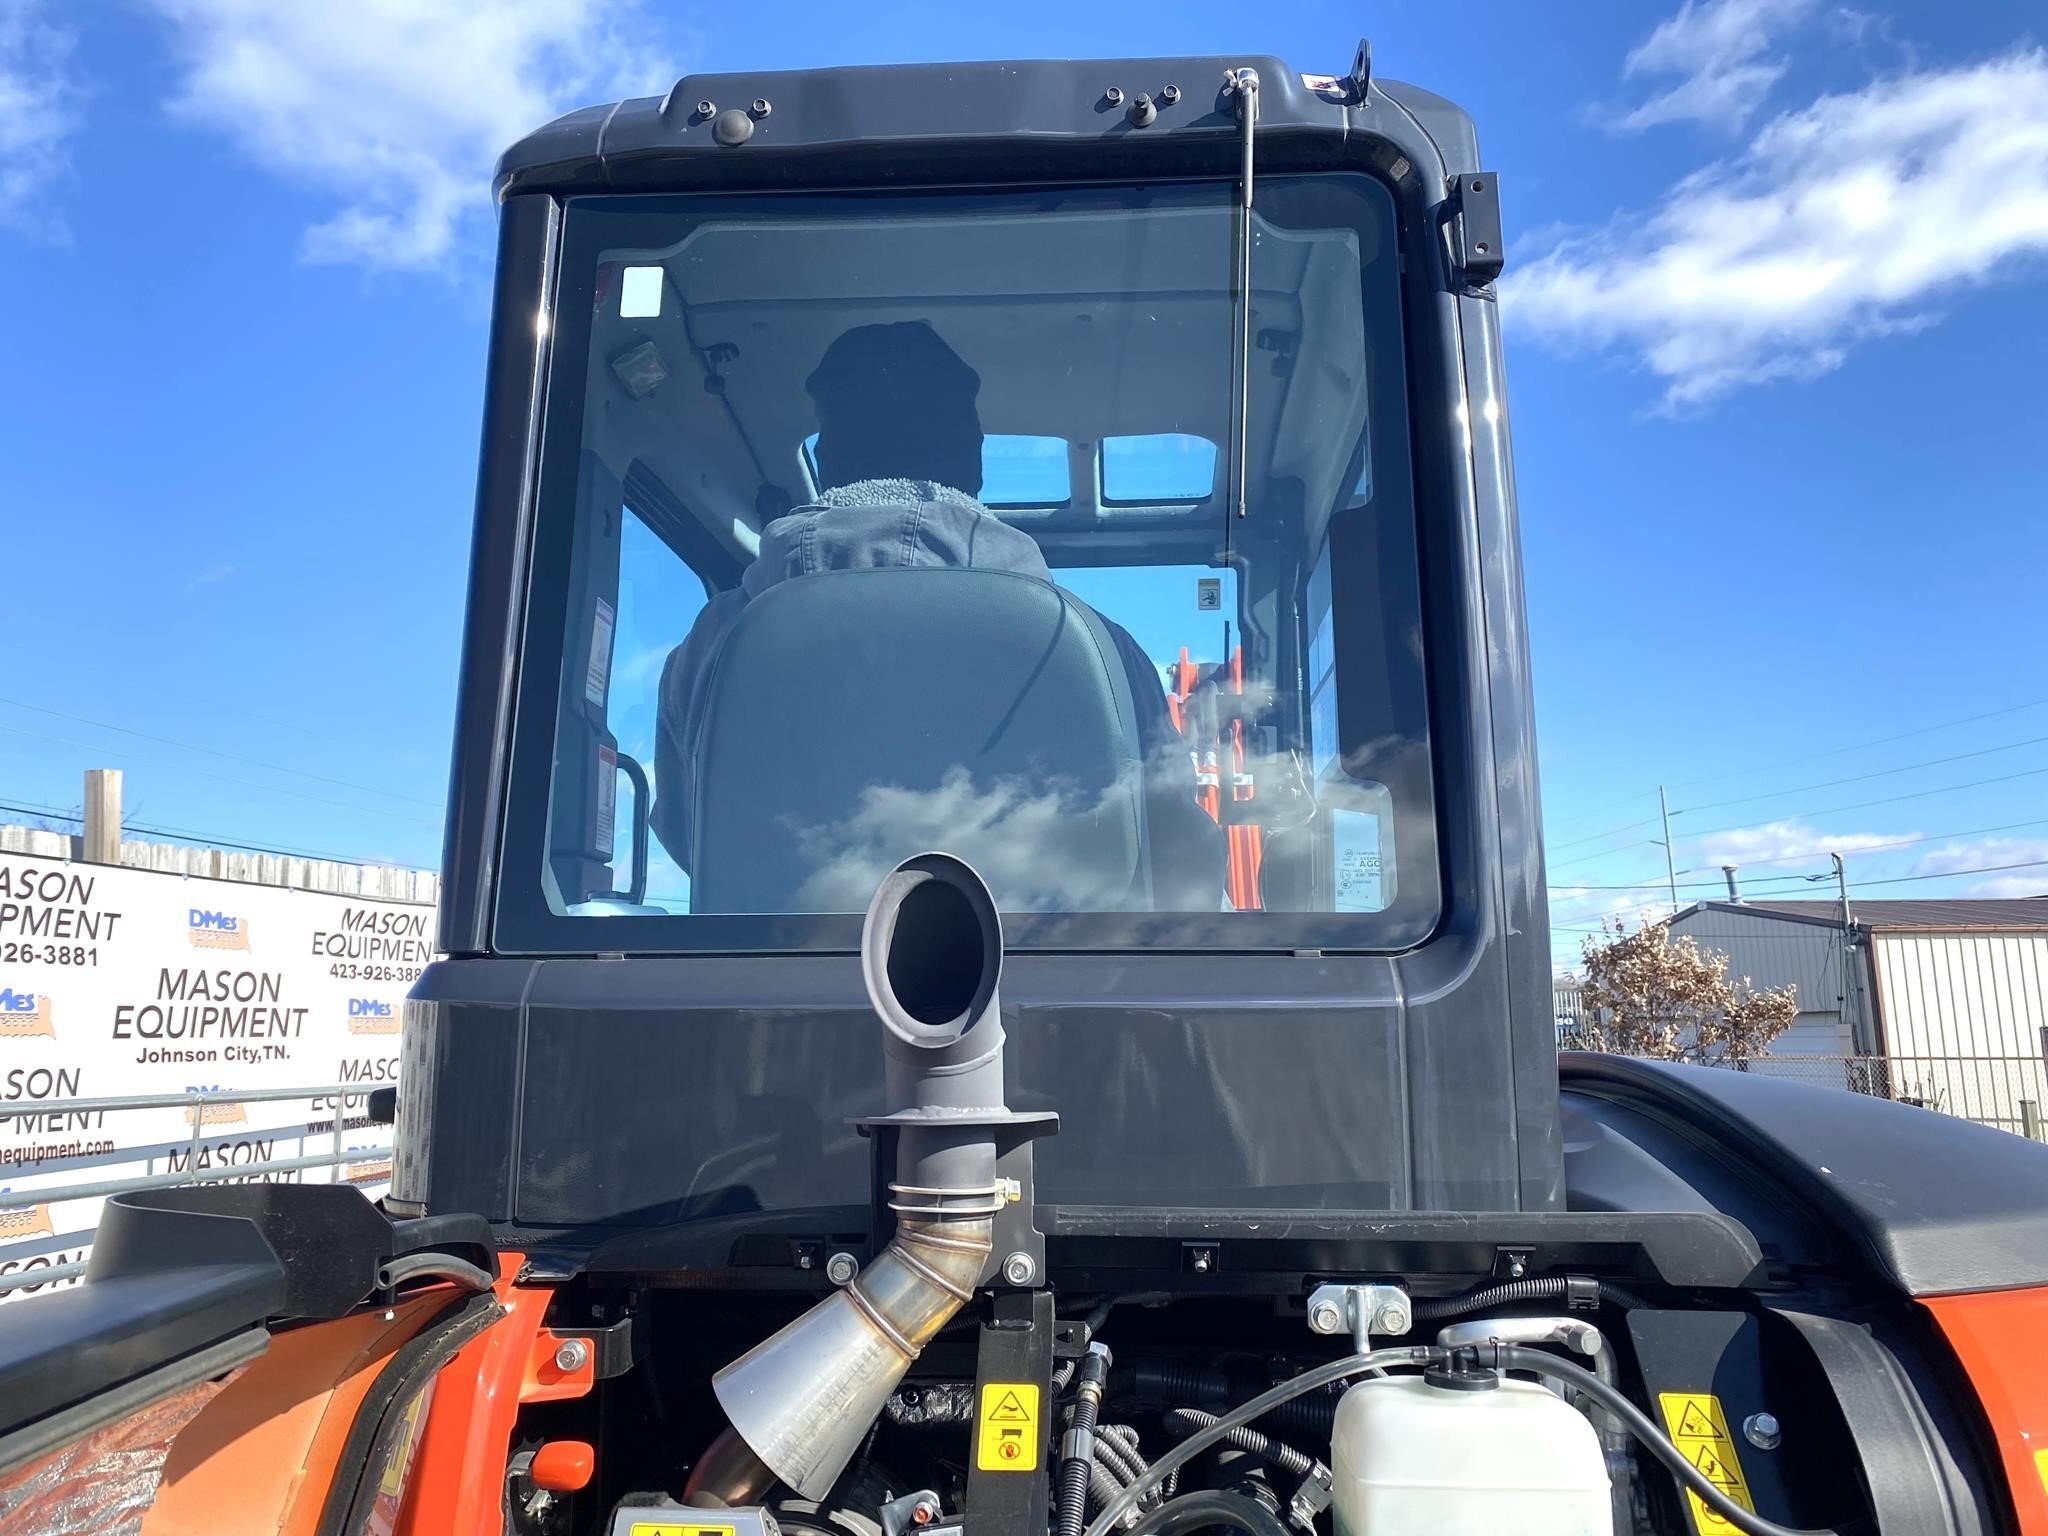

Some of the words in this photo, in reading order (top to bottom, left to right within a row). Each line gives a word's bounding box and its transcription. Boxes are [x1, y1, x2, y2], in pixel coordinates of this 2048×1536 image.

[0, 867, 94, 905] ASON
[0, 903, 121, 941] PMENT
[341, 908, 427, 937] MASON
[0, 942, 97, 966] 26-3881
[312, 931, 438, 962] EQUIPMEN
[157, 968, 281, 1003] MASON
[330, 962, 422, 982] 423-926-388
[112, 1005, 309, 1039] EQUIPMENT
[136, 1047, 217, 1063] Johnson
[0, 1067, 80, 1100] SON
[0, 1139, 114, 1168] equipment.com
